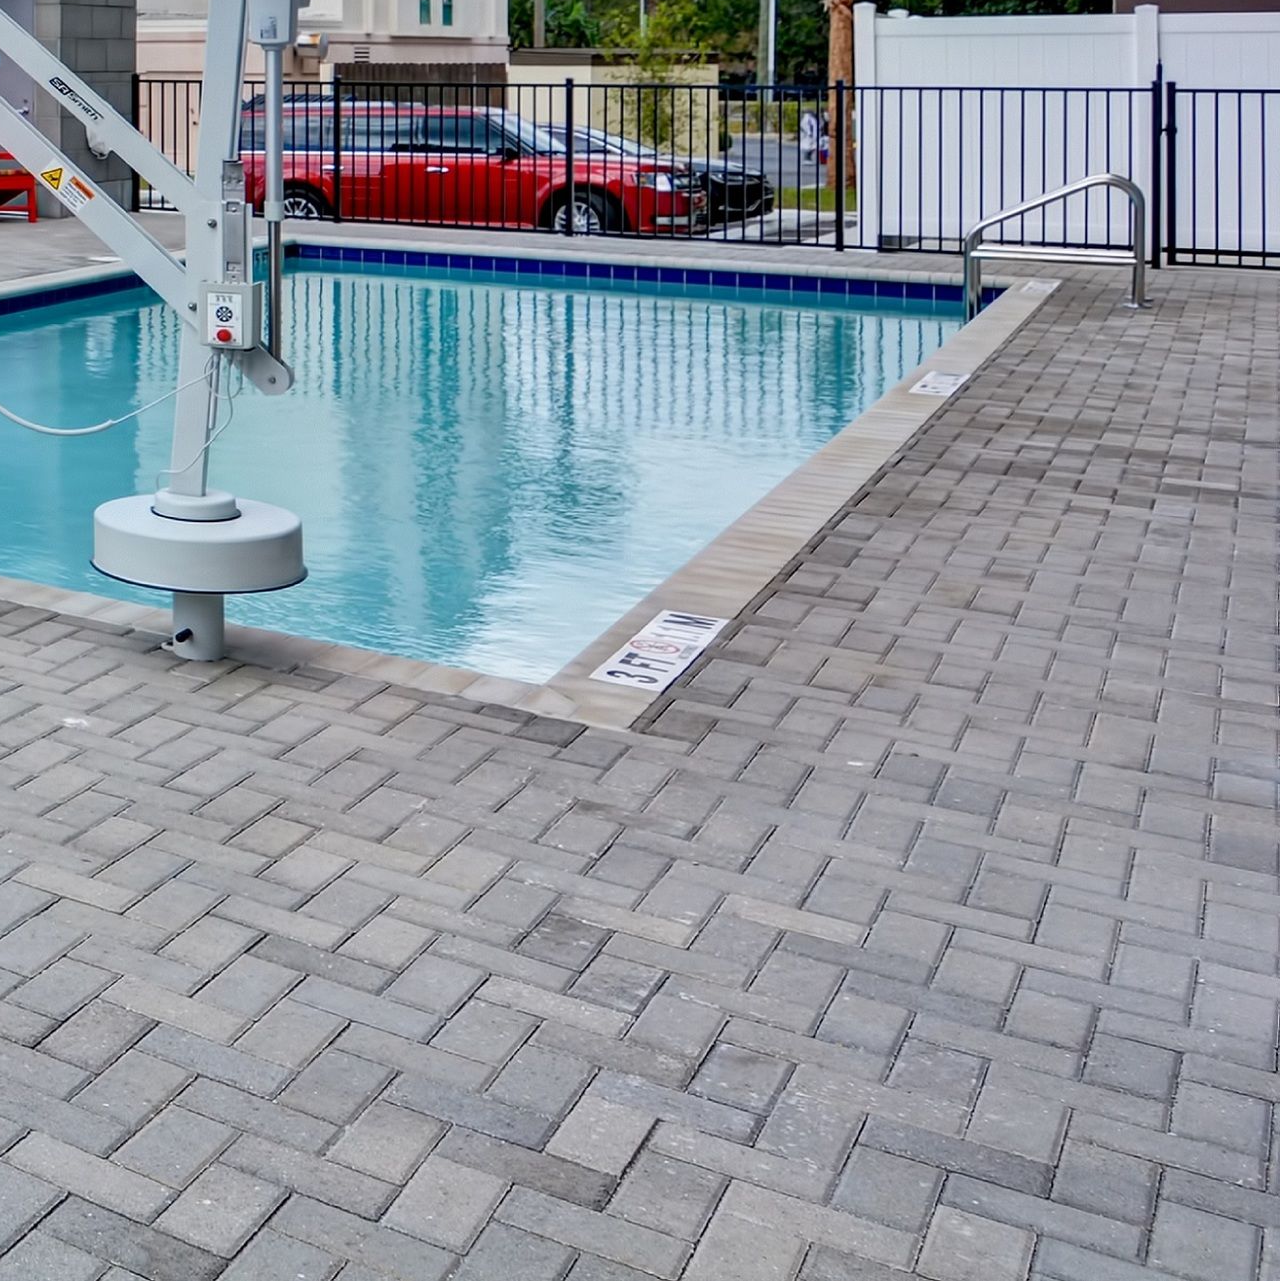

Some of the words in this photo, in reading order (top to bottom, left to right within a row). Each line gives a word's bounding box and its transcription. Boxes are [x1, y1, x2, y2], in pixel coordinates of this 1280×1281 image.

[662, 613, 719, 630] M
[618, 651, 677, 673] FT
[606, 670, 659, 684] 3
